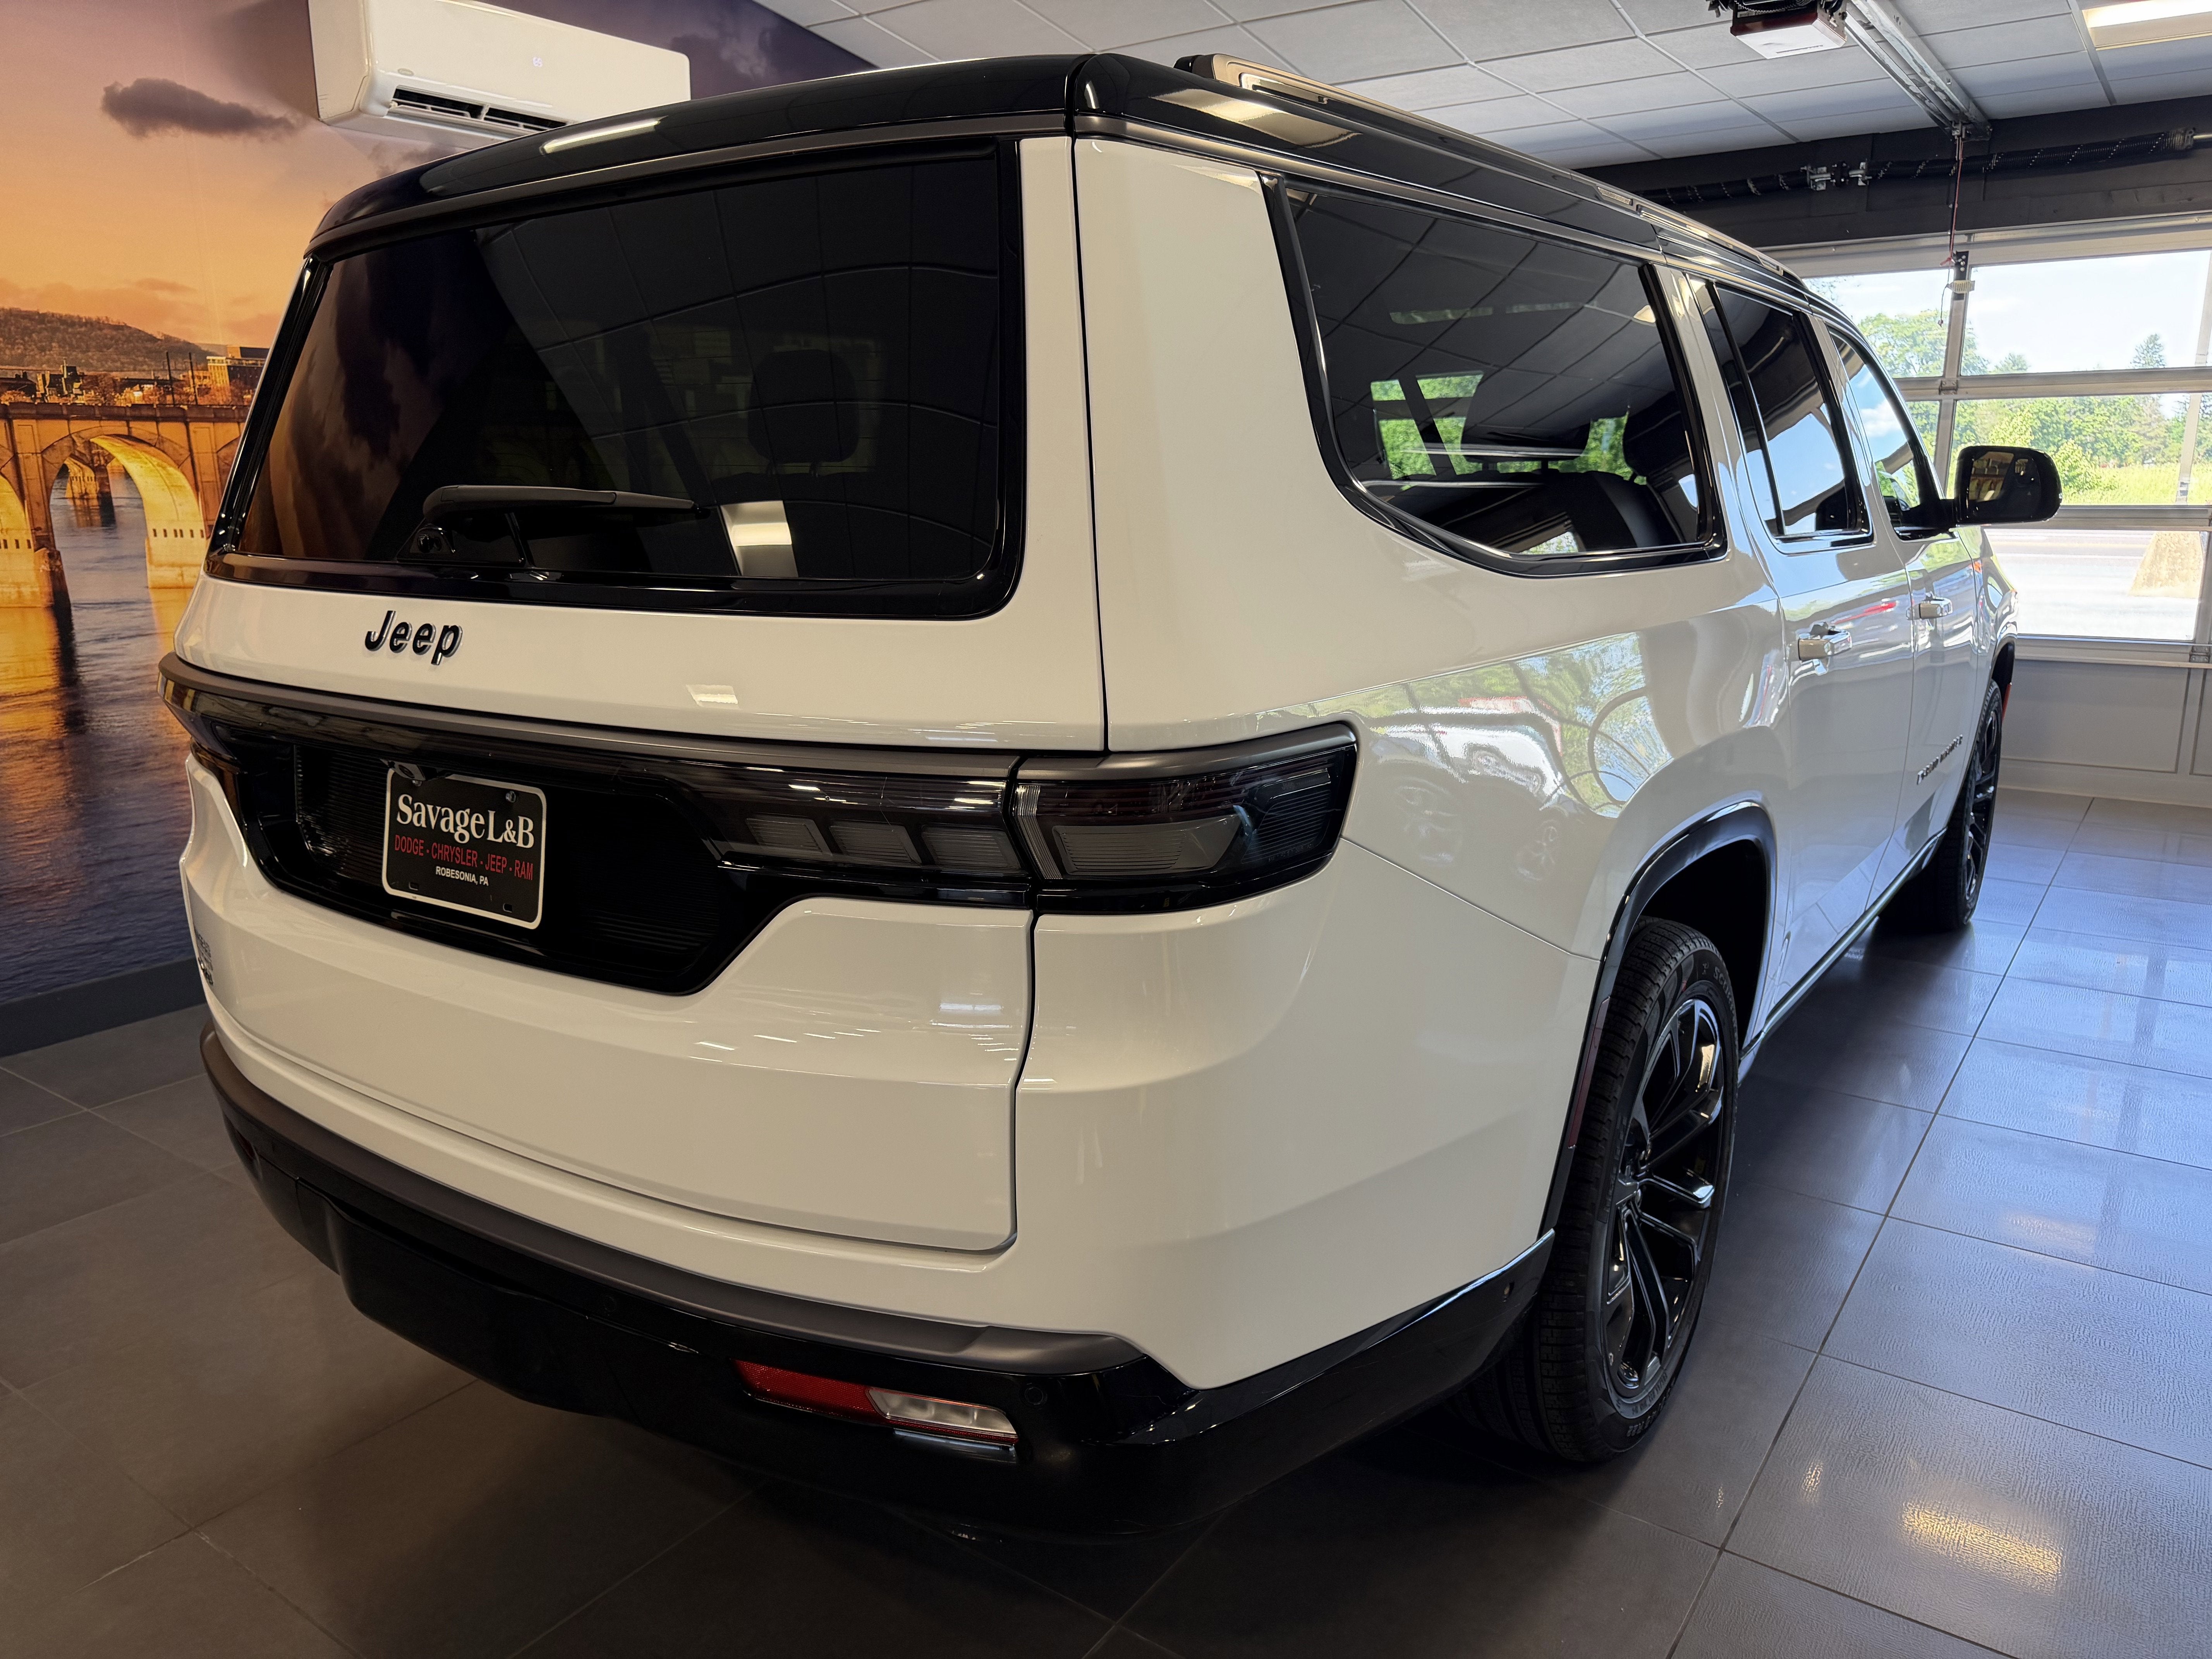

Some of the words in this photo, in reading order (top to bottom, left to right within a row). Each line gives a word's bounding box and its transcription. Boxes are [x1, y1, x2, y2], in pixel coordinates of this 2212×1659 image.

[365, 610, 463, 665] Jeep
[395, 835, 424, 856] DODGE
[431, 842, 477, 868] CHRYSLER
[485, 854, 507, 874] JEEP
[514, 860, 533, 880] RAM
[436, 866, 478, 885] ROBESONIA,
[480, 875, 489, 886] PA
